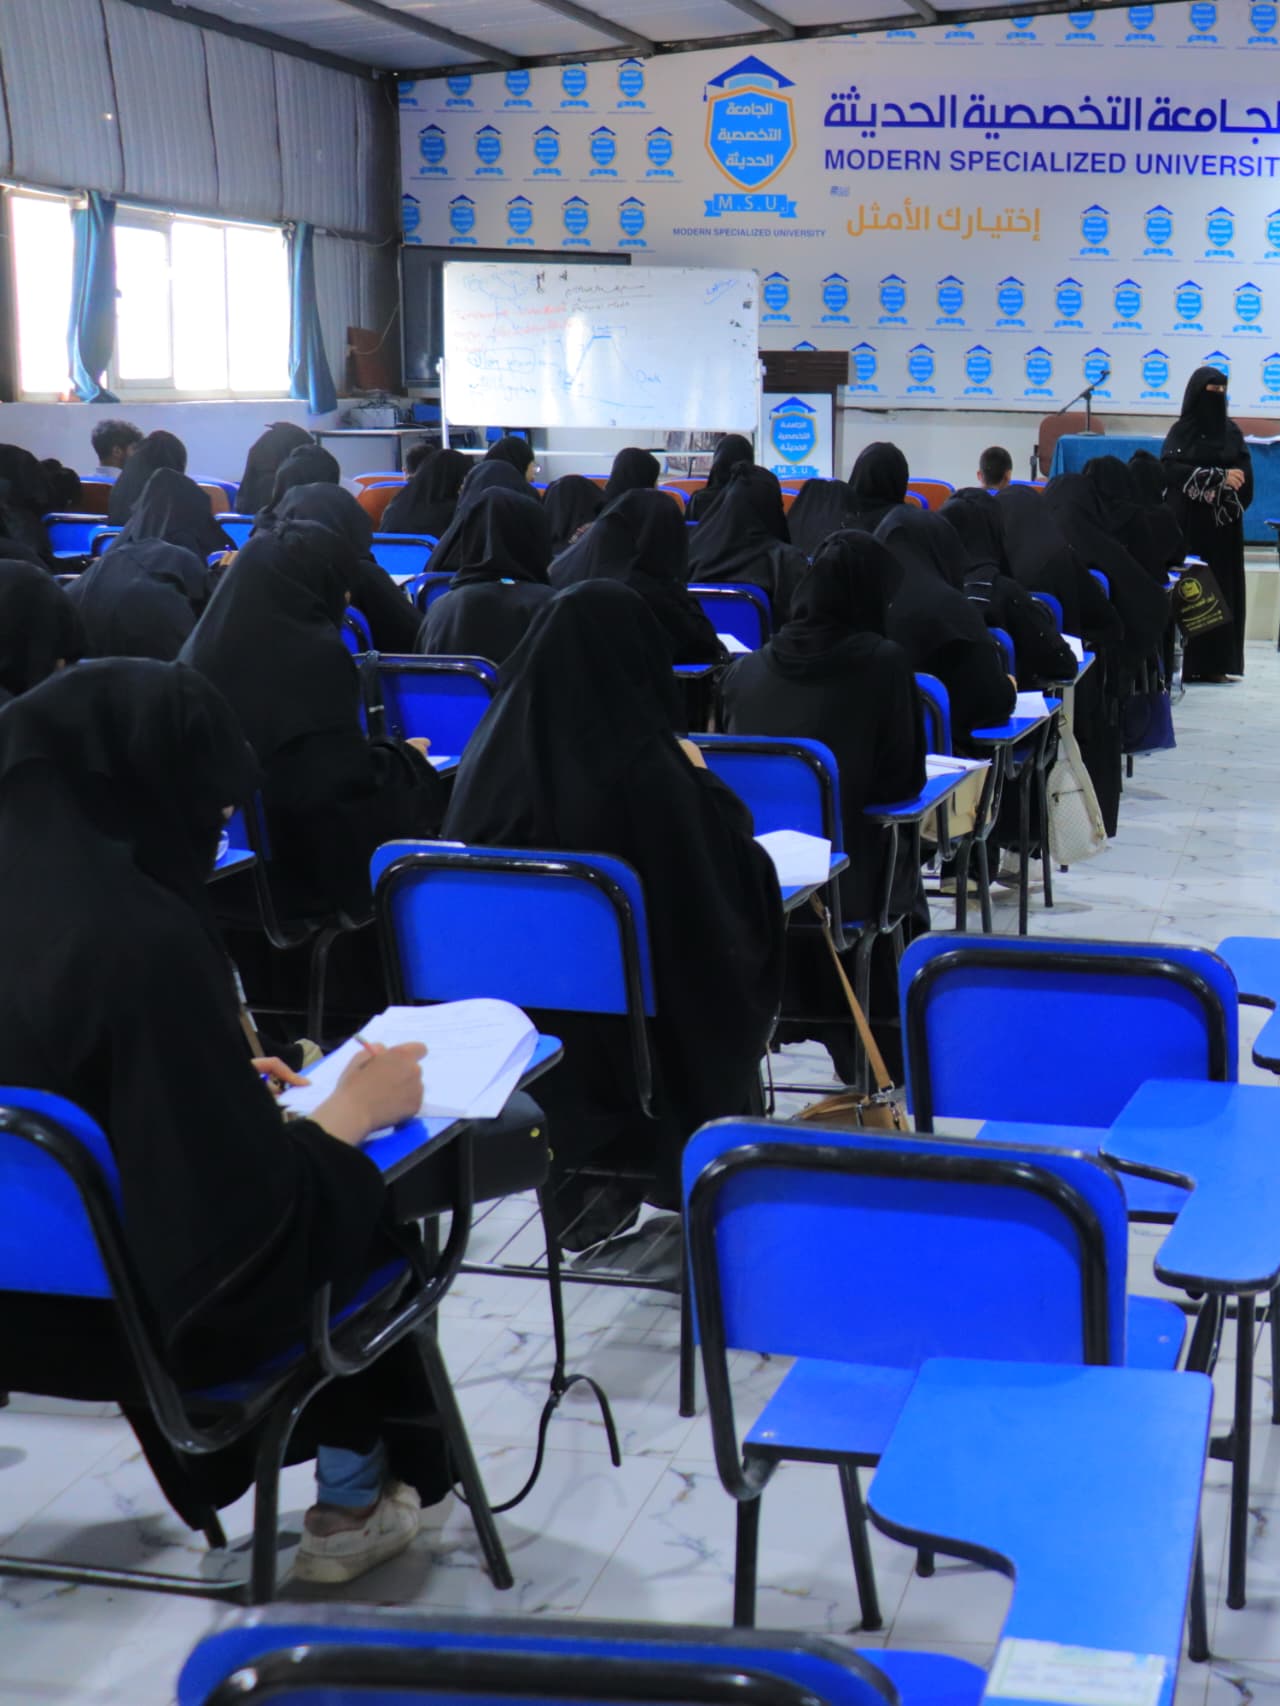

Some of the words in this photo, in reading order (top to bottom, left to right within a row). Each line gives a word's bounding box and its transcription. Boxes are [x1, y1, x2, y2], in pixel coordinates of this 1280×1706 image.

[725, 102, 774, 118] الجامعة
[823, 85, 957, 139] الحديثة
[962, 93, 1142, 140] التخصصية
[717, 127, 782, 143] التخصصية
[725, 151, 774, 170] الحديثة
[824, 149, 941, 171] MODERN
[949, 149, 1127, 175] SPECIALIZED
[847, 197, 930, 237] الأمثل
[672, 227, 712, 237] MODERN
[713, 227, 771, 238] SPECIALIZED
[773, 228, 827, 238] UNIVERSITY
